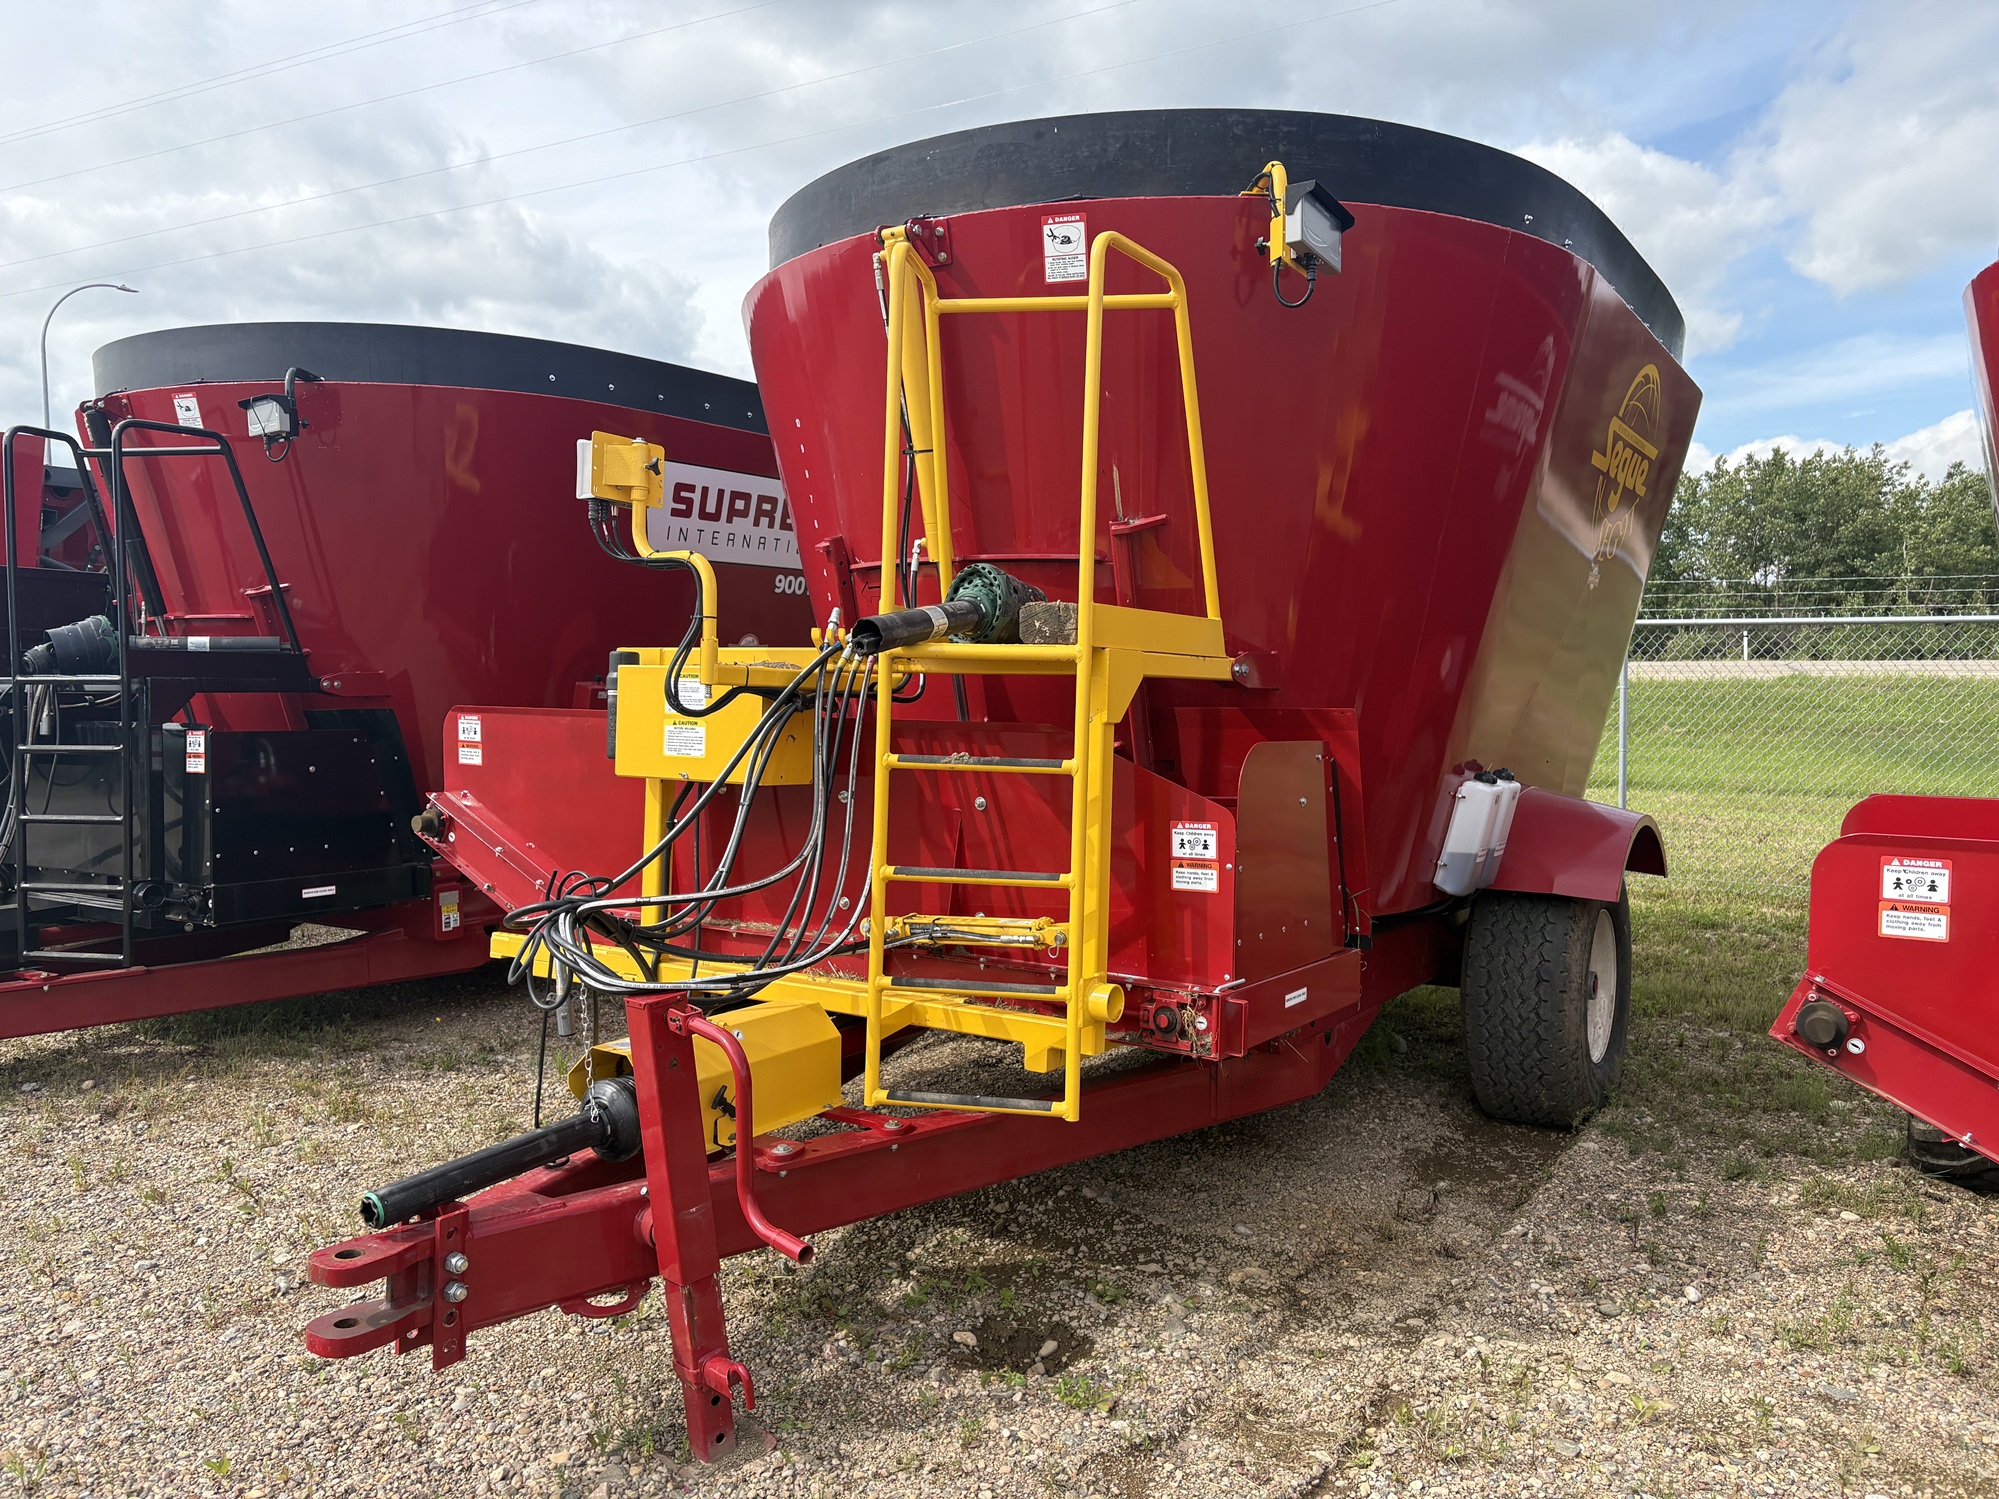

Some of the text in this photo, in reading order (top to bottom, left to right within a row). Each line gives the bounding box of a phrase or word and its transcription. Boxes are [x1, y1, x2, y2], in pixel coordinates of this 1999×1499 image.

[1591, 416, 1658, 512] Segue
[667, 526, 799, 554] INTERNATI
[774, 574, 809, 595] 900
[1903, 859, 1942, 868] DANGER
[1902, 905, 1940, 914] WARNING
